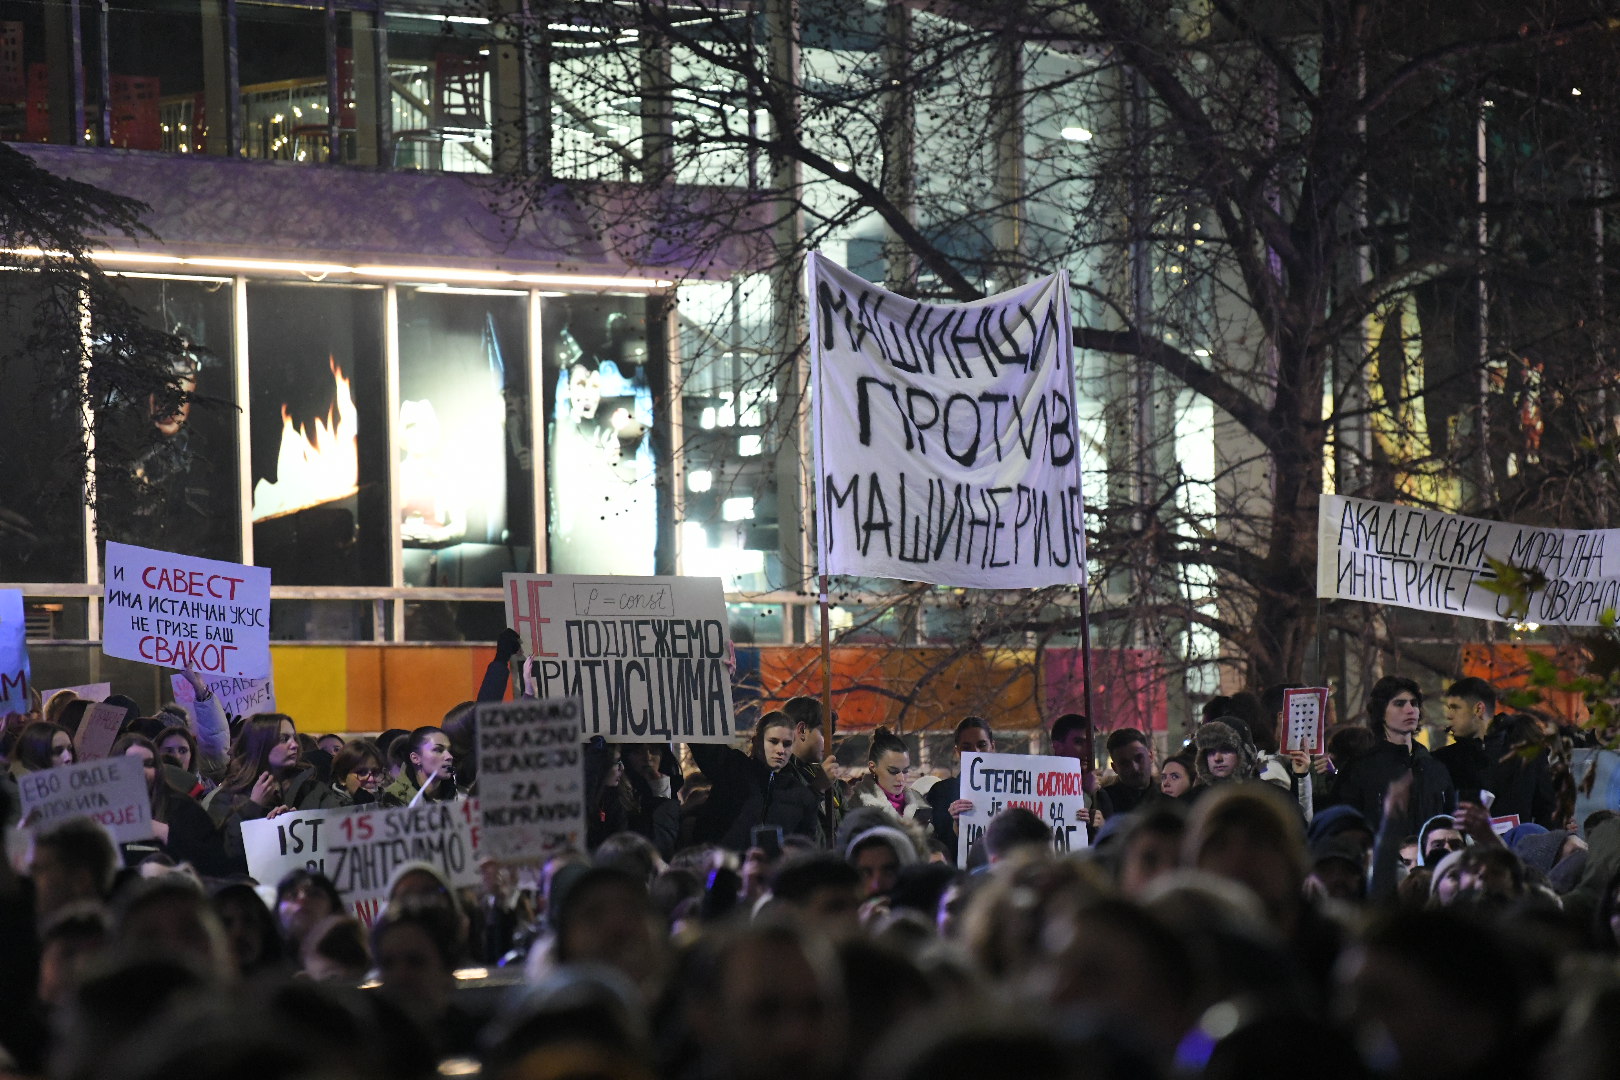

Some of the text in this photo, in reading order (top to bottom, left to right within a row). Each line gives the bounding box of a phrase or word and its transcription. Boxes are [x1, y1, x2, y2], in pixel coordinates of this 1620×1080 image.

[819, 281, 1060, 378] МАШИНЦИ
[857, 377, 1075, 467] ПРОТИВ
[1338, 501, 1492, 567] АКАДЕМСКИ
[1507, 529, 1605, 578] МОРАЛНА
[113, 566, 244, 600] И САВЕСТ
[619, 588, 666, 610] const
[1336, 550, 1479, 612] ИНТЕГРИТЕТ
[109, 589, 265, 627] ИМА ИСТАНЧАН УКУС
[510, 580, 558, 657] НЕ
[131, 616, 234, 643] НЕ ГРИЗЕ БАШ
[565, 619, 724, 659] ПОДЛЕЖЕМО
[511, 783, 541, 800] ZA
[340, 814, 374, 842] 15
